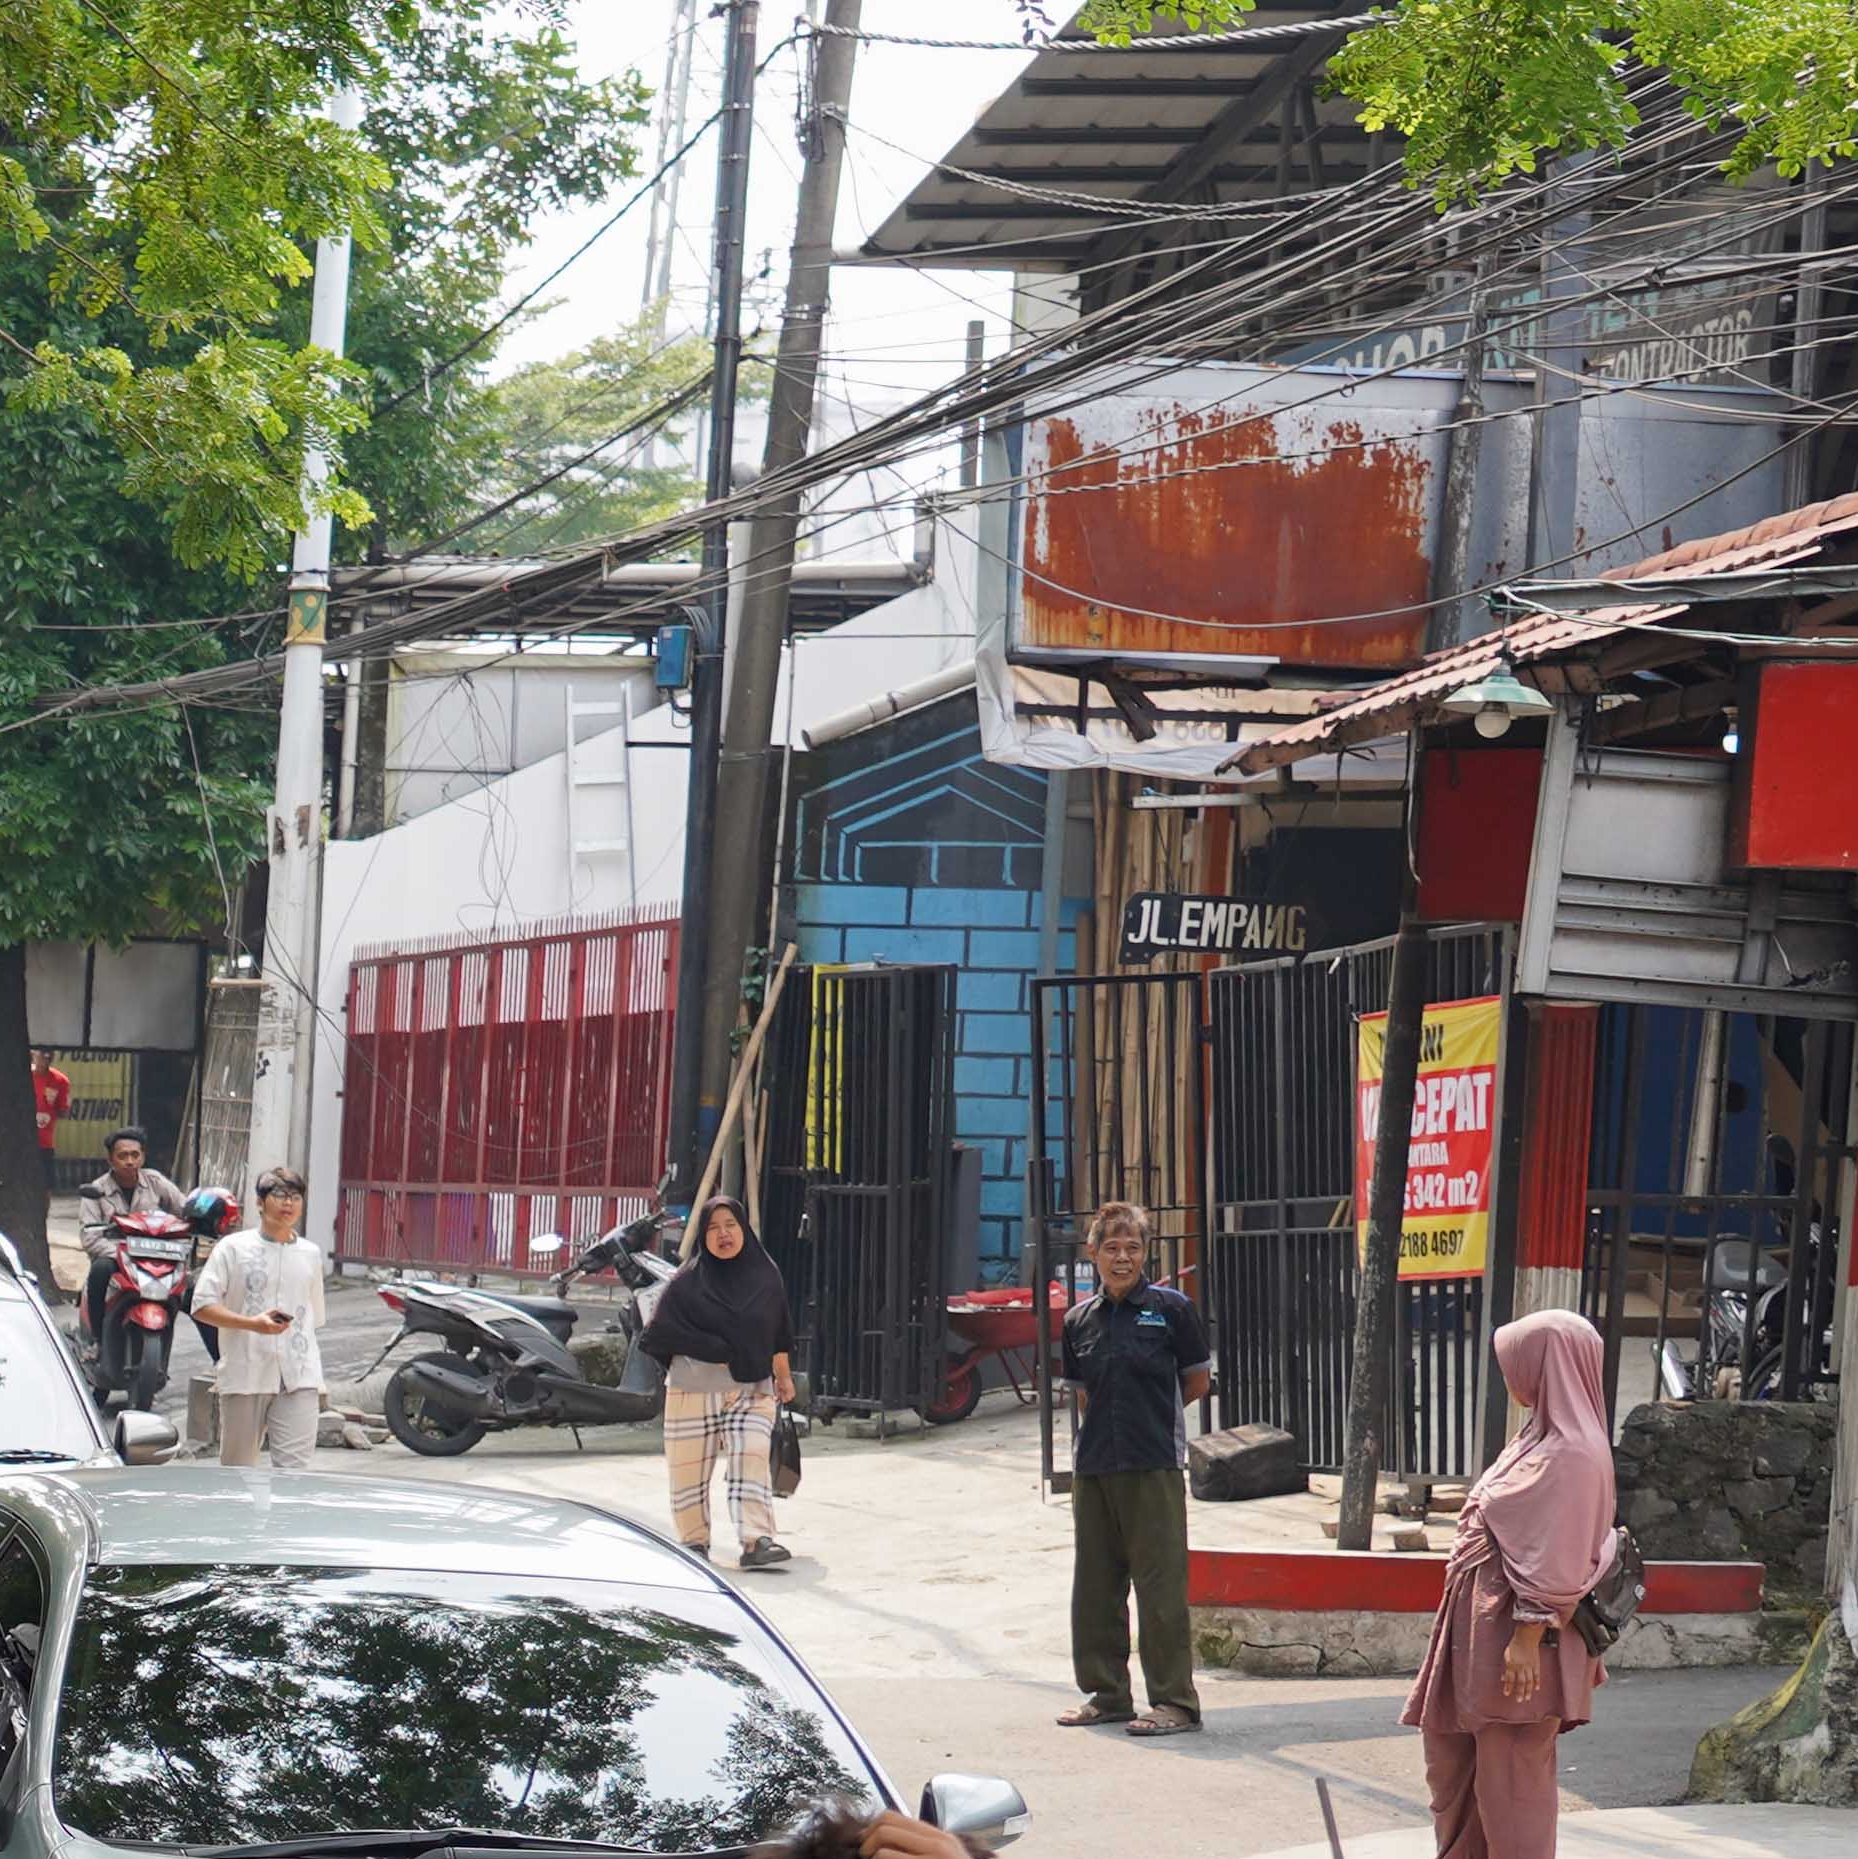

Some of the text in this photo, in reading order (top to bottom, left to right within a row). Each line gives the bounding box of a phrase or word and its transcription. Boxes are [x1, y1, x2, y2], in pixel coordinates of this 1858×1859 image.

[1411, 1072, 1491, 1138] CEPAT
[1412, 1172, 1445, 1211] 342
[1448, 1170, 1479, 1207] m2
[1430, 1229, 1465, 1257] 4697
